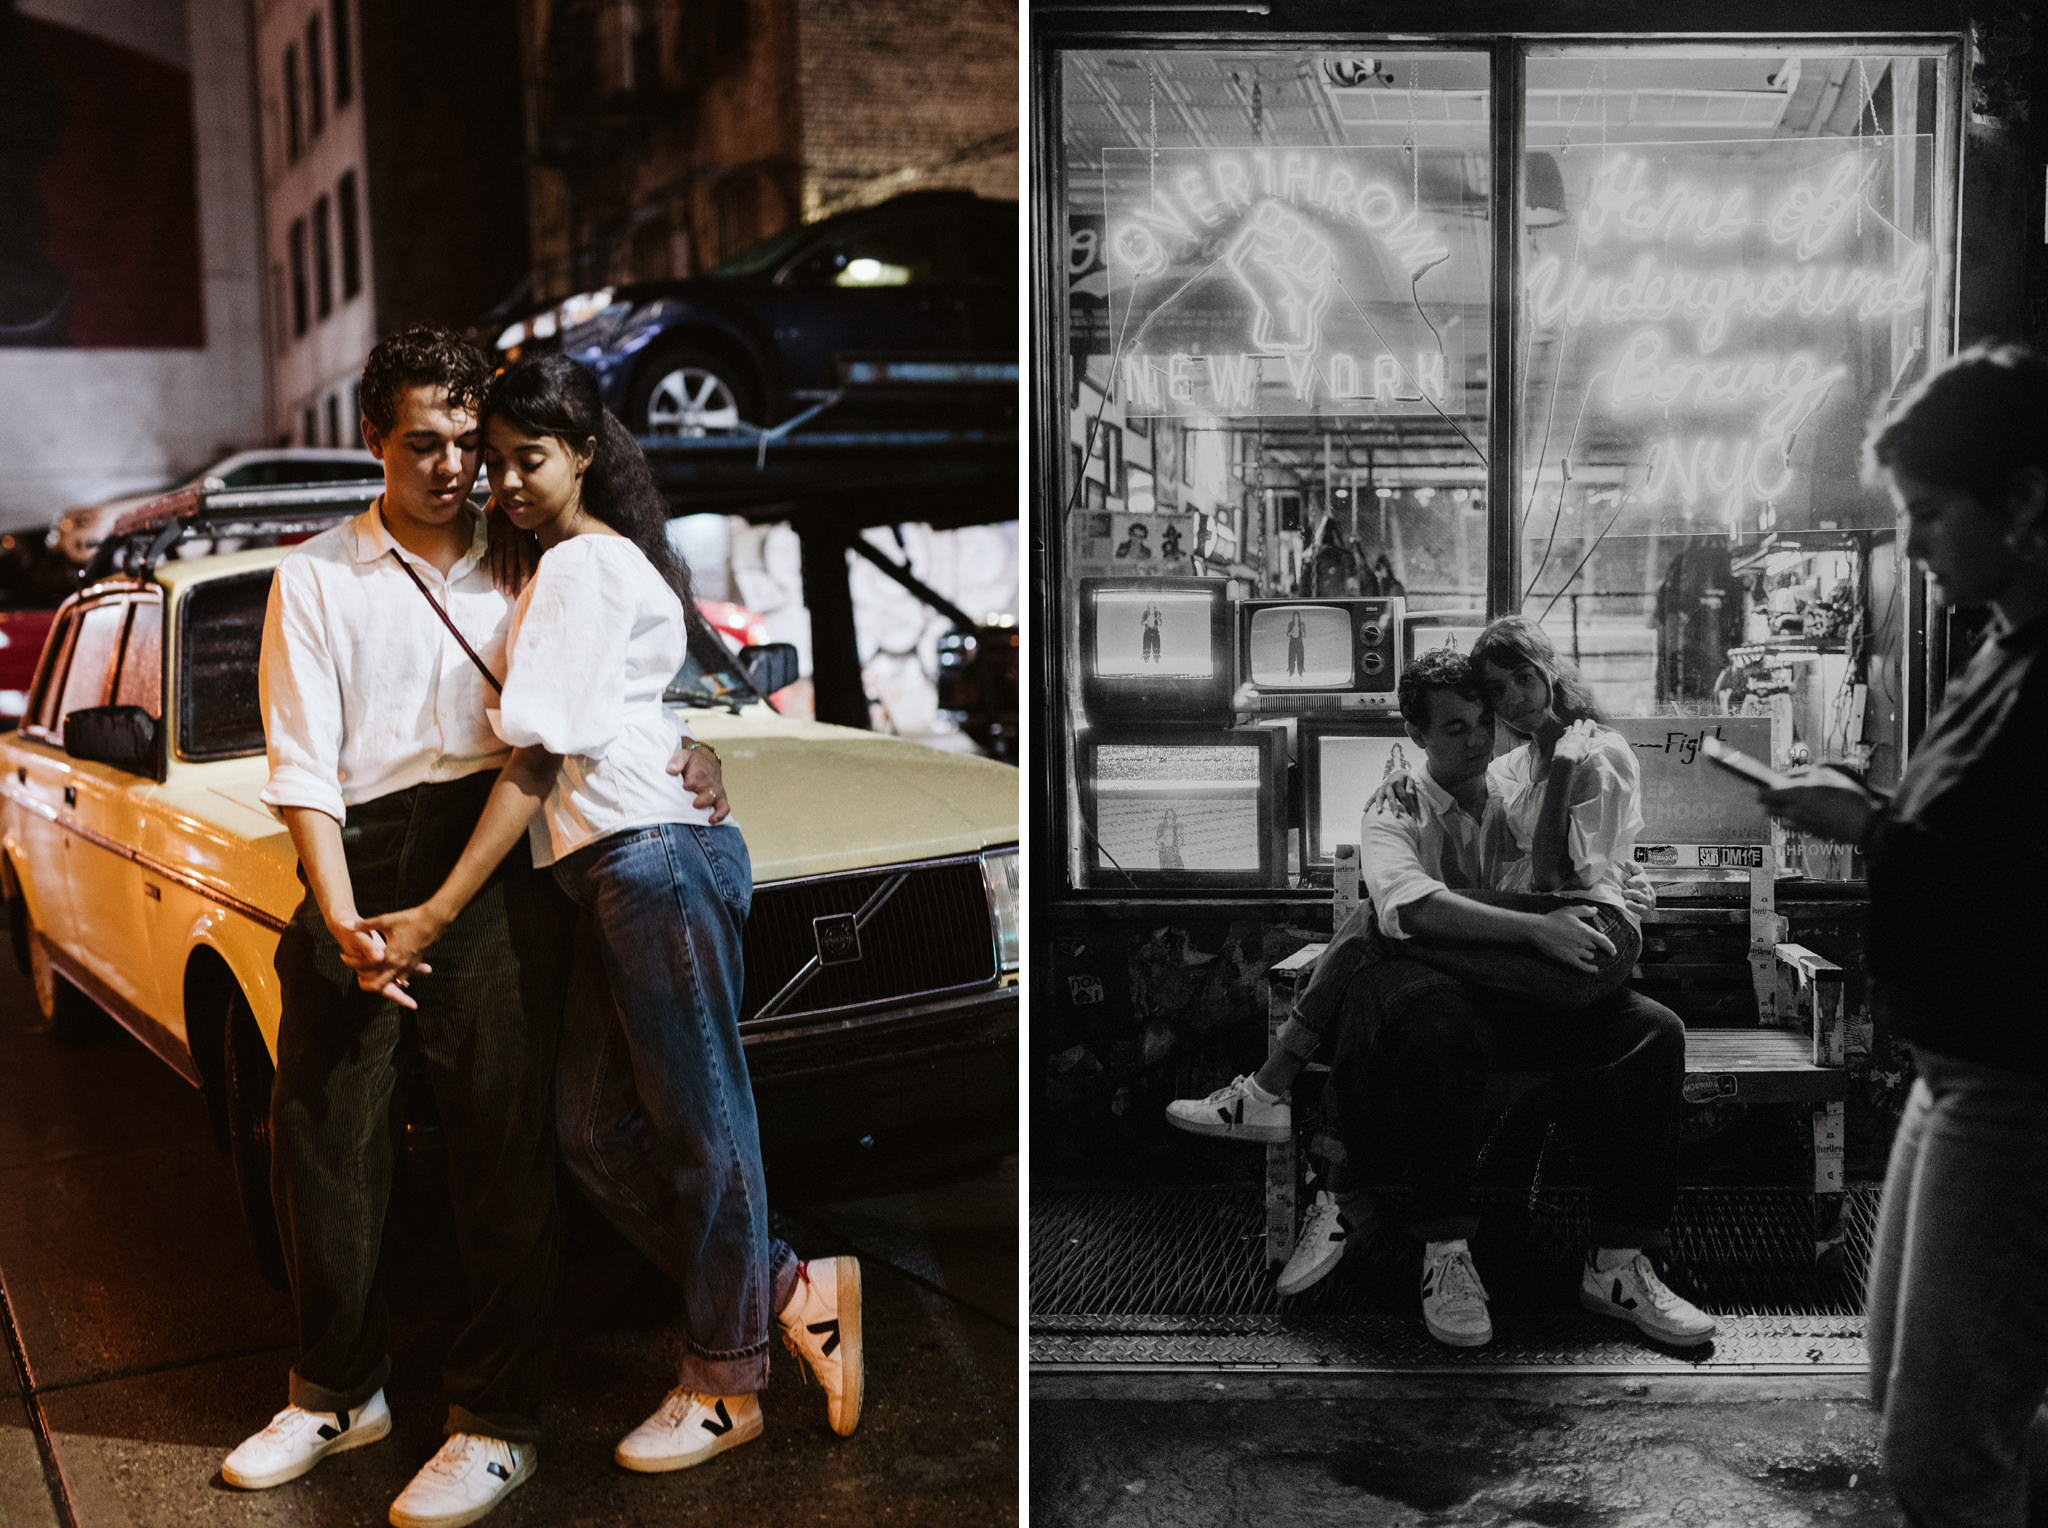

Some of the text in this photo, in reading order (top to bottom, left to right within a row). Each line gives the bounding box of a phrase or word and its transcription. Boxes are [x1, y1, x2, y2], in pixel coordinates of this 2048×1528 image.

[1113, 151, 1449, 279] OVERTHROW
[1580, 152, 1860, 259] Home of
[1527, 247, 1930, 352] Underground
[1124, 353, 1449, 406] NEW YORK
[1611, 331, 1846, 437] Boxing
[1646, 438, 1794, 522] NYC
[1700, 854, 1719, 866] SAID
